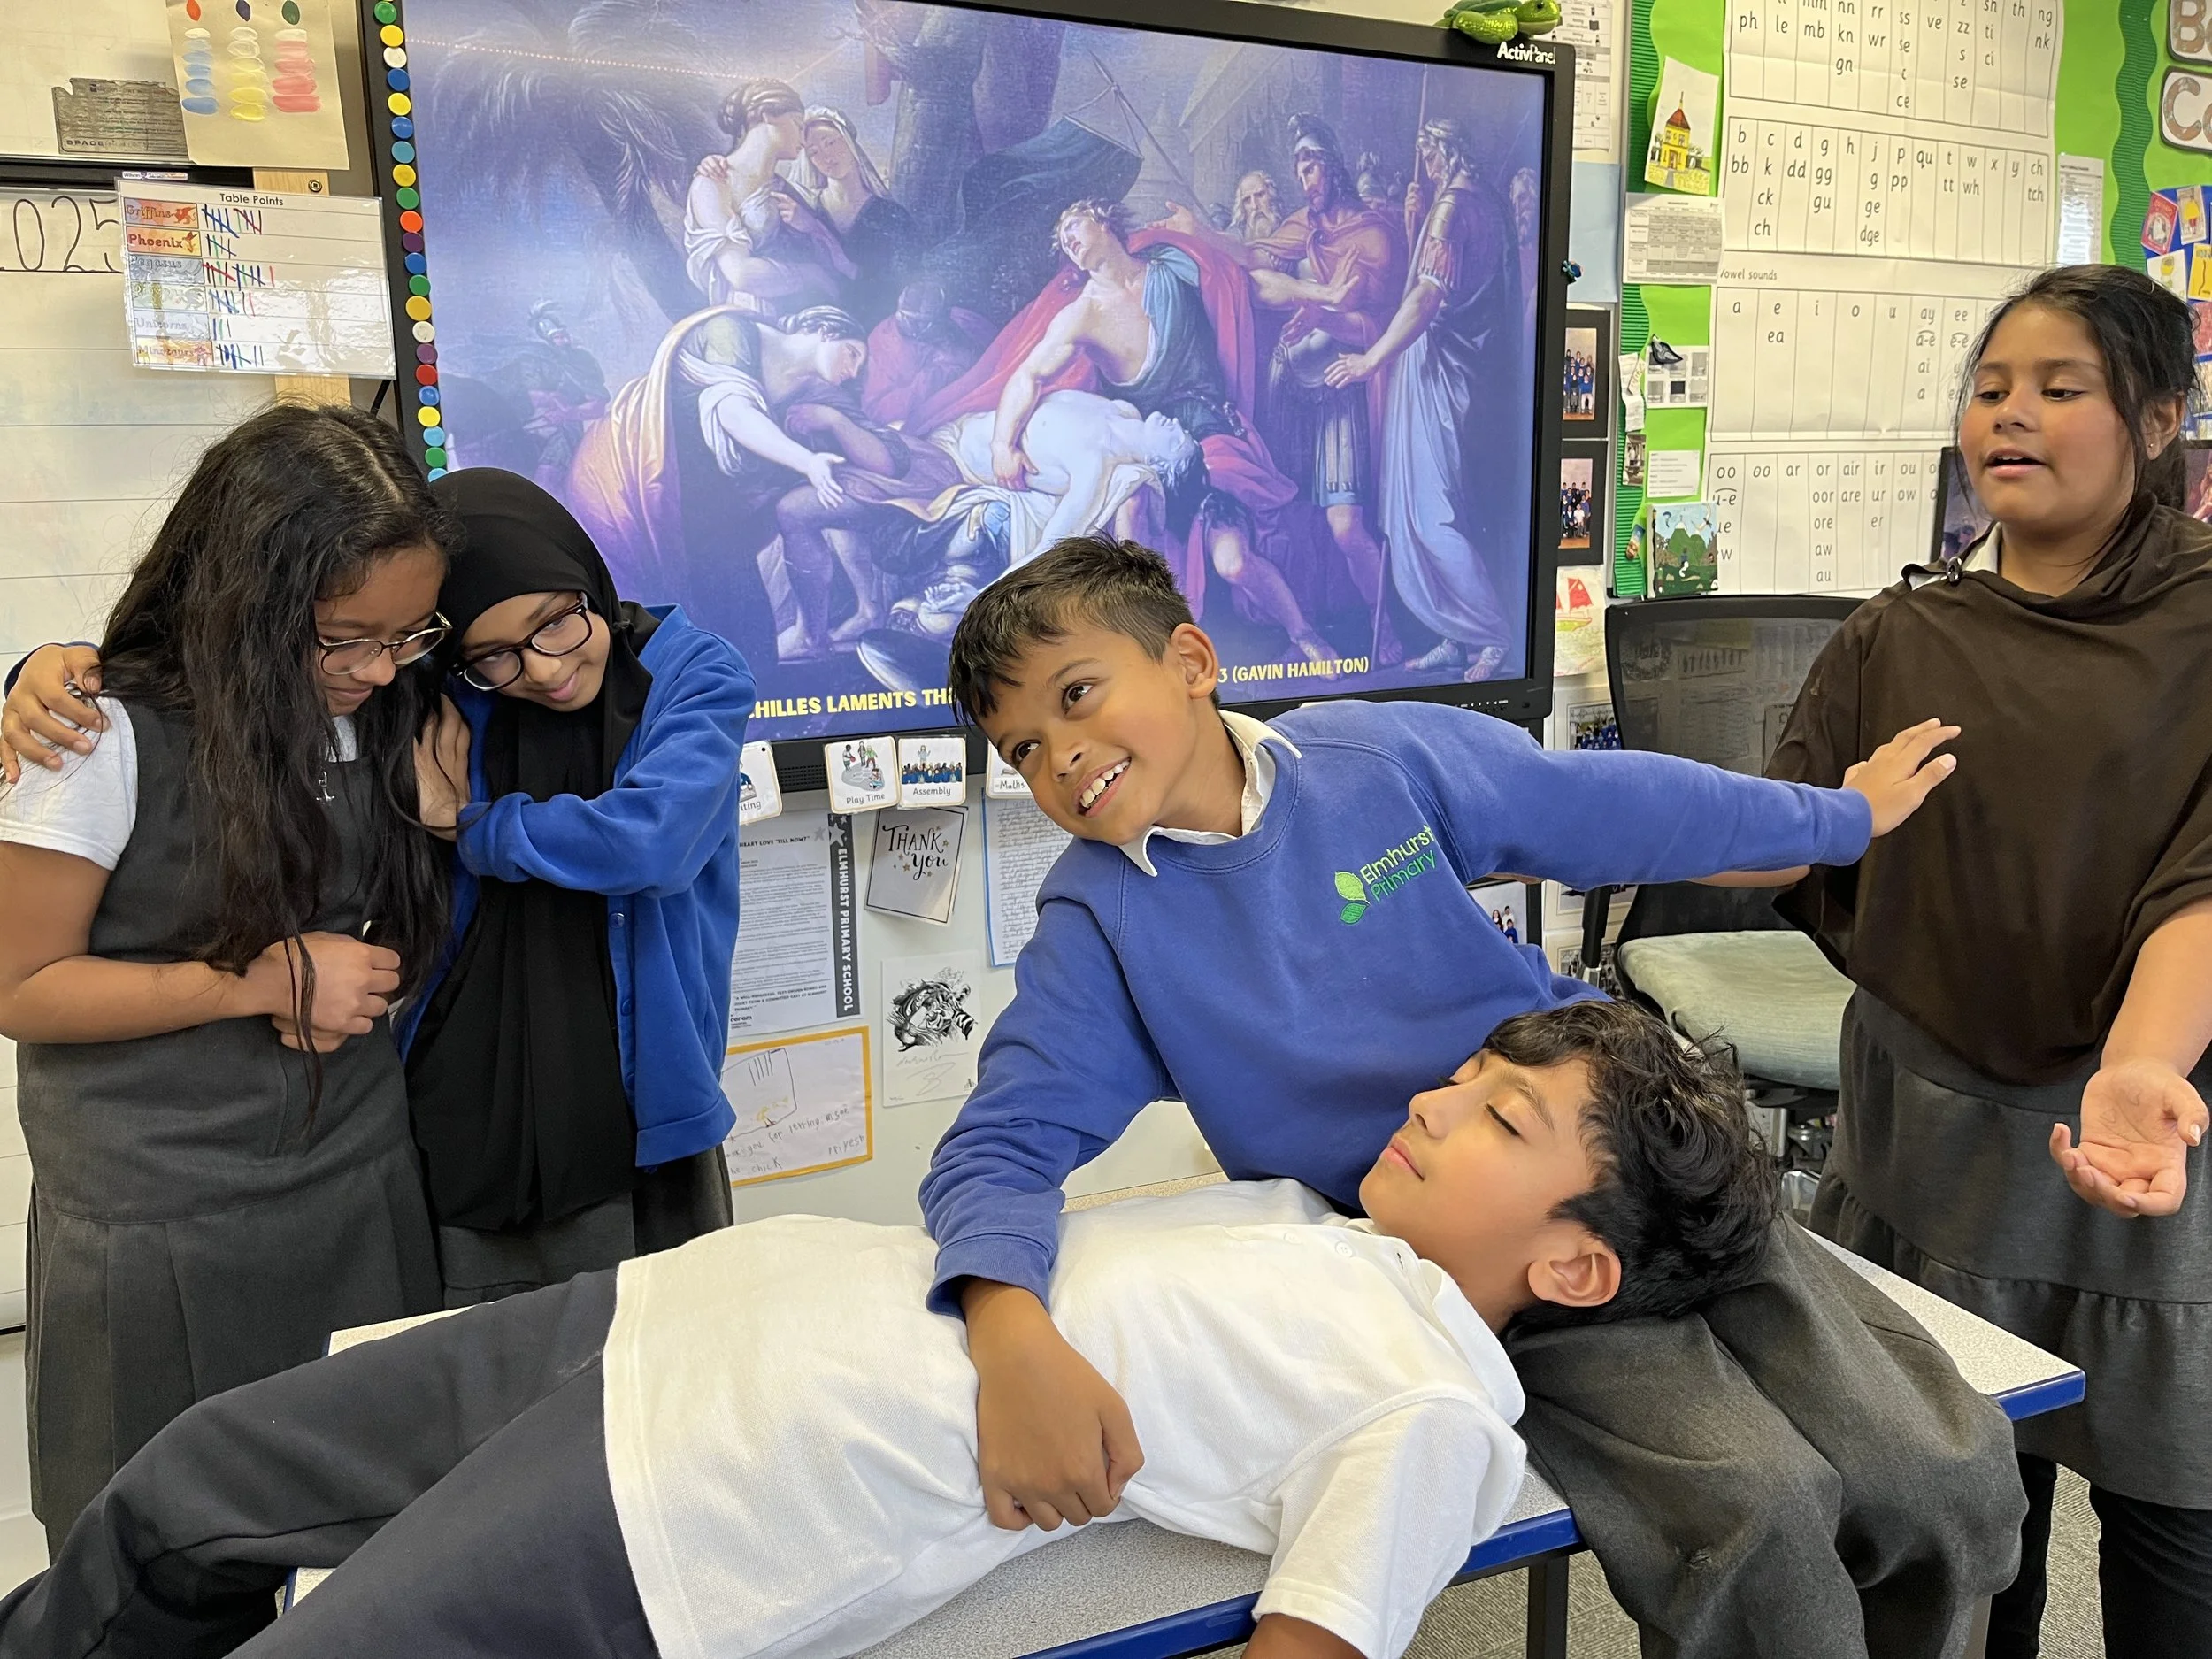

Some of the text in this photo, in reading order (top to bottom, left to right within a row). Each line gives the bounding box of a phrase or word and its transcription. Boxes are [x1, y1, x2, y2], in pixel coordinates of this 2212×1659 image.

[2012, 3, 2024, 18] th
[2038, 9, 2053, 27] ng
[1838, 1, 1855, 15] nn
[1871, 6, 1884, 19] rr
[1899, 12, 1910, 25] ss
[1927, 16, 1942, 29] ve
[1957, 21, 1970, 35] zz
[1985, 24, 1994, 40] ti
[2172, 0, 2212, 56] B
[1739, 11, 1994, 66] ph le mb kn wr se s ci
[2034, 32, 2050, 50] nk
[1496, 41, 1556, 65] ActivPanel
[1835, 58, 1853, 76] gn
[1953, 75, 1968, 89] se
[1896, 95, 1910, 108] ce
[2162, 76, 2212, 145] C
[1738, 124, 2043, 178] b c d g h j p qu t w x y ch
[1731, 155, 2044, 203] bb k dd gg g pp tt wh tch
[220, 193, 284, 206] Table Points
[1757, 188, 1881, 218] ck gu ge
[127, 204, 173, 219] Griffins
[0, 196, 123, 273] 025
[127, 233, 183, 249] Phoenix
[1754, 218, 1880, 247] ch dge
[129, 255, 182, 270] Pegasus
[1748, 269, 1778, 280] sounds
[1732, 300, 1969, 325] a e i o u ay ee
[1767, 330, 1785, 343] ea
[1918, 358, 1931, 373] ai
[1917, 388, 1925, 400] a
[1717, 467, 1736, 479] oo
[1753, 465, 1771, 478] oo
[1786, 465, 1800, 477] ar
[1816, 464, 1831, 476] or
[1843, 460, 1861, 476] air
[1875, 460, 1886, 476] ir
[1900, 463, 1916, 475] ou
[1812, 490, 1834, 503] oor
[1841, 489, 1862, 503] are
[1871, 489, 1886, 503] ur
[1897, 488, 1916, 501] ow
[1814, 517, 1833, 530] ore
[1870, 516, 1883, 528] er
[1815, 543, 1832, 557] aw
[1816, 570, 1831, 582] au
[1233, 662, 1283, 684] (GAVIN
[1287, 656, 1370, 679] HAMILTON)
[749, 697, 822, 718] HILLES
[826, 691, 918, 714] LAMENTS
[912, 787, 952, 796] Assembly
[1000, 780, 1025, 789] Maths
[846, 793, 886, 805] Play Time
[882, 824, 944, 856] THANK
[1359, 824, 1435, 885] Elmhurst
[910, 853, 949, 881] you
[1371, 849, 1436, 902] Primary
[838, 848, 854, 1011] ELMHURST PRIMARY SCHOOL
[768, 1131, 783, 1143] for
